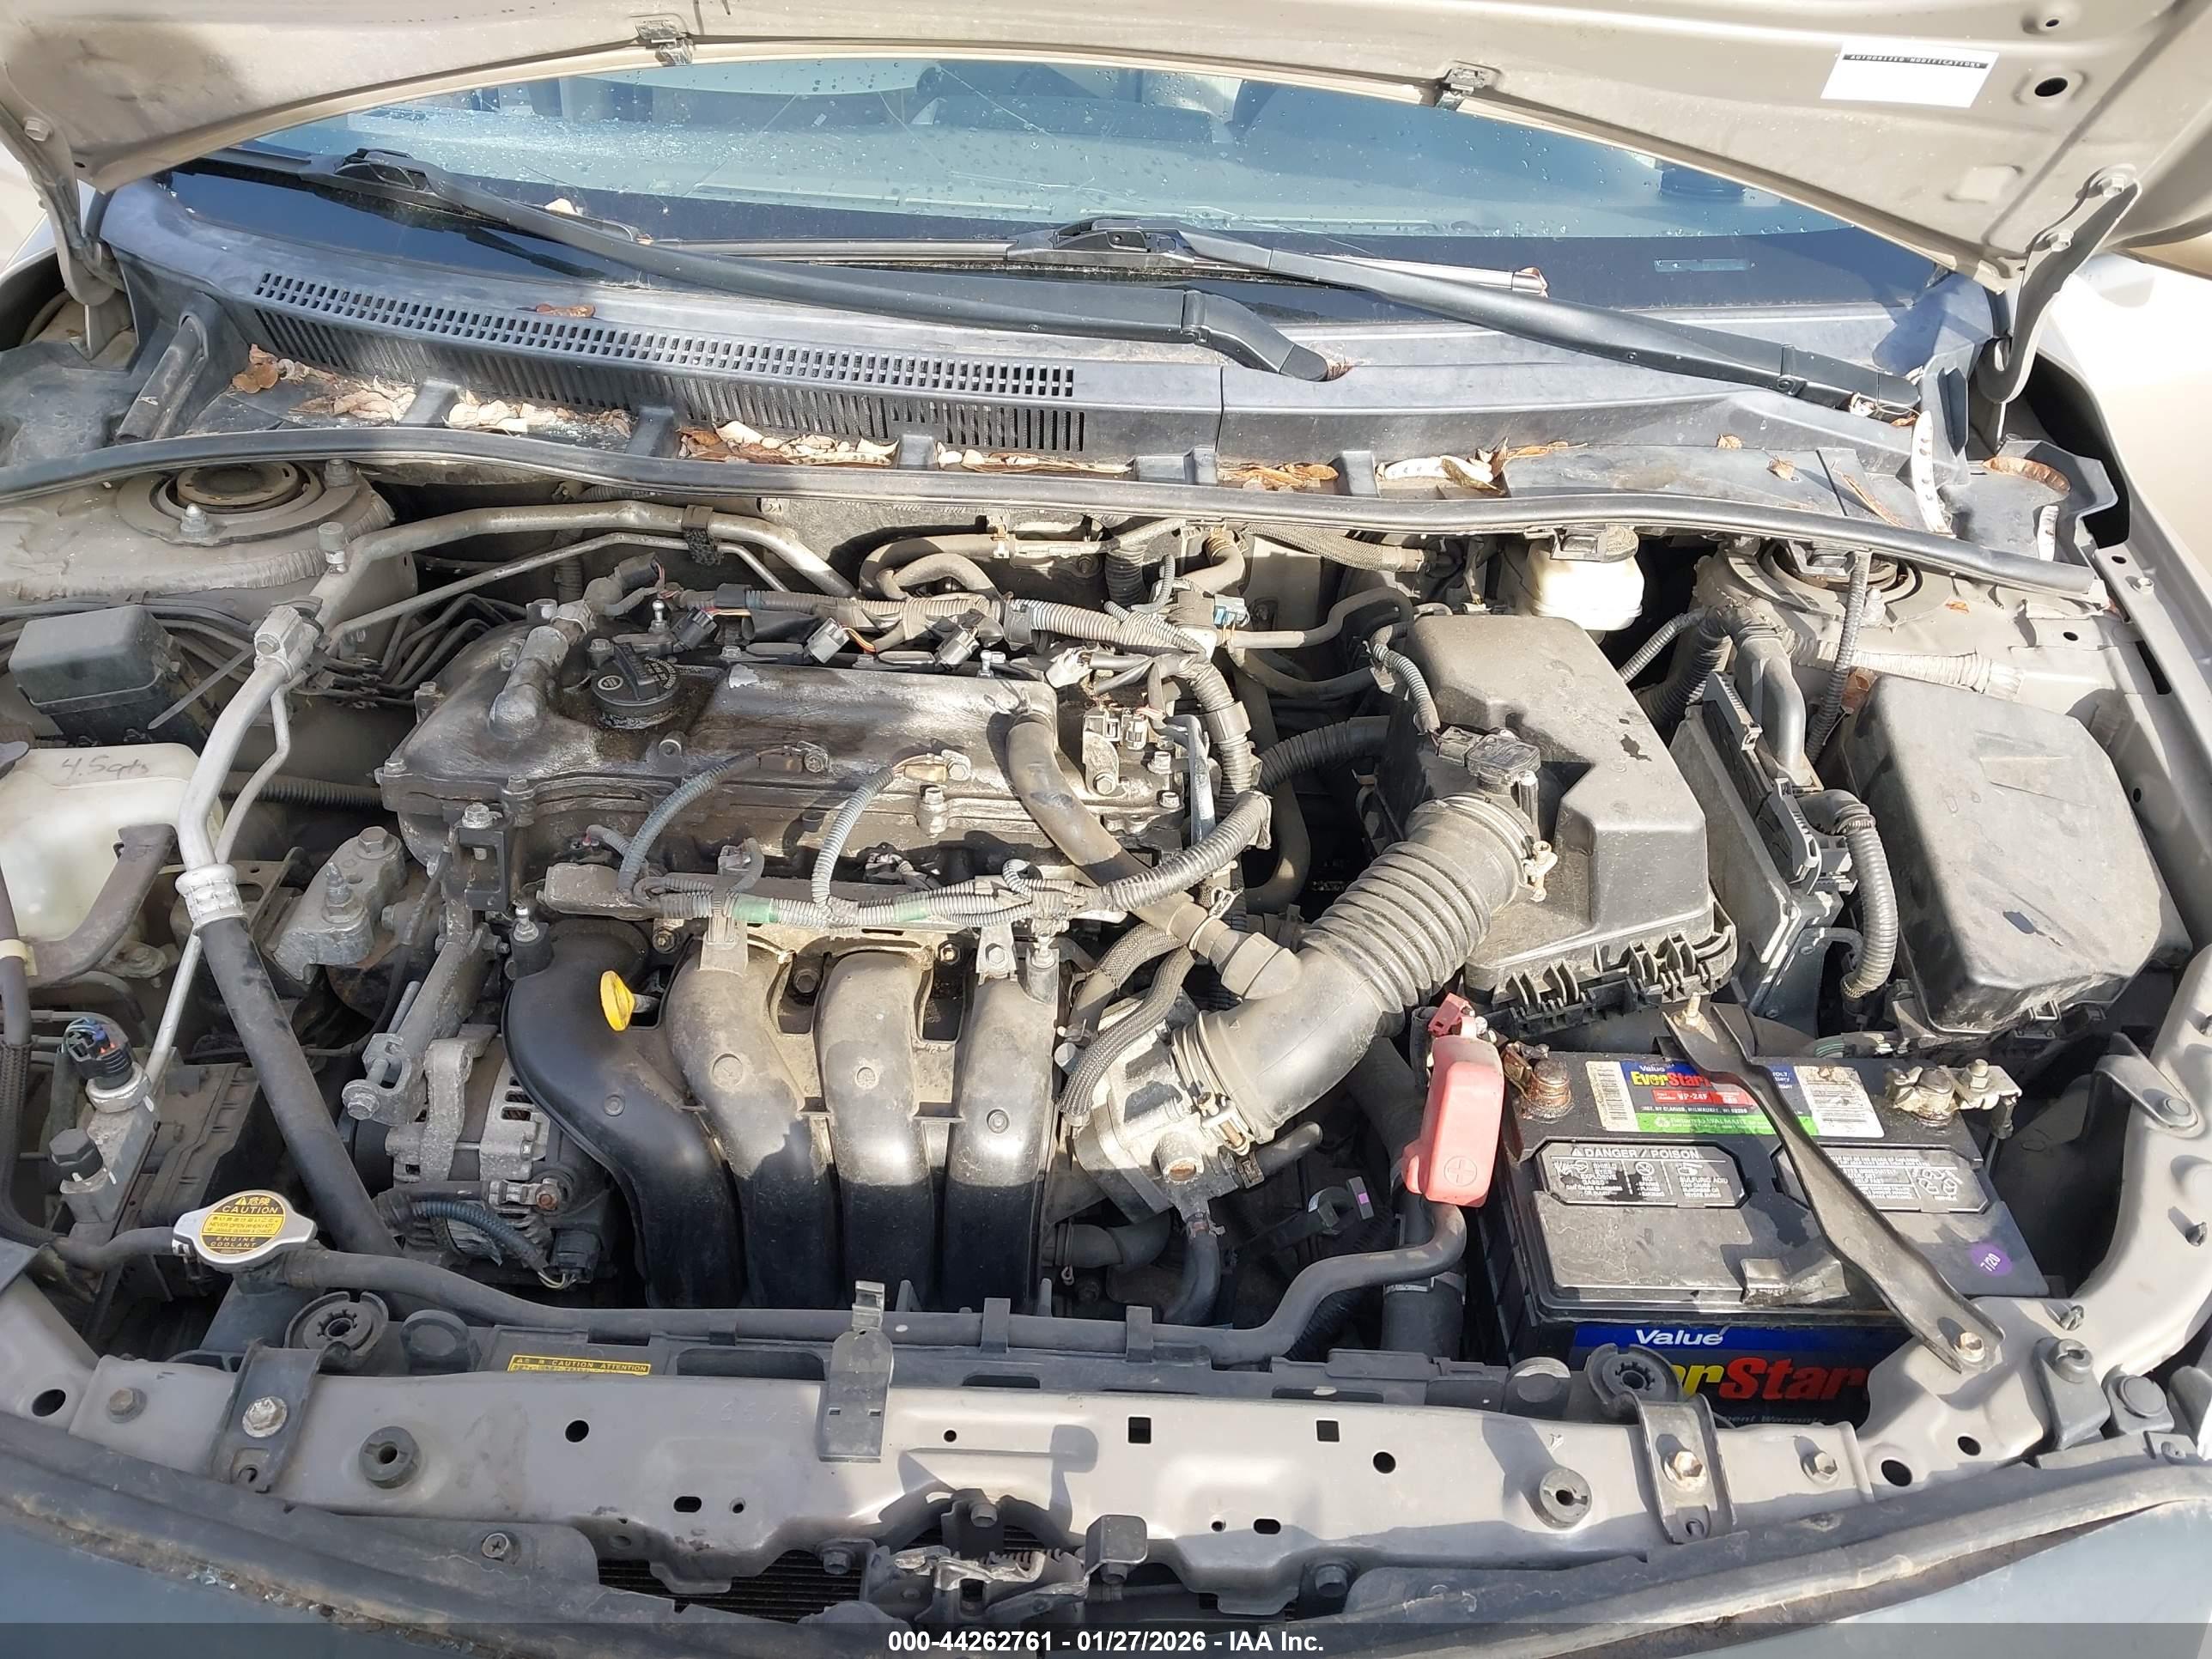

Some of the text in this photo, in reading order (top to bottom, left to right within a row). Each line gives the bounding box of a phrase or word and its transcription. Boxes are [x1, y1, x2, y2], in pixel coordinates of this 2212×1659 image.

[1584, 1148, 1638, 1158] DANGER
[1651, 1149, 1700, 1159] POISON
[222, 1206, 279, 1214] CAUTION
[1980, 1253, 2001, 1271] 7/20
[1635, 1329, 1724, 1346] Value
[551, 1359, 594, 1369] CAUTION
[599, 1363, 647, 1372] ATTENTION
